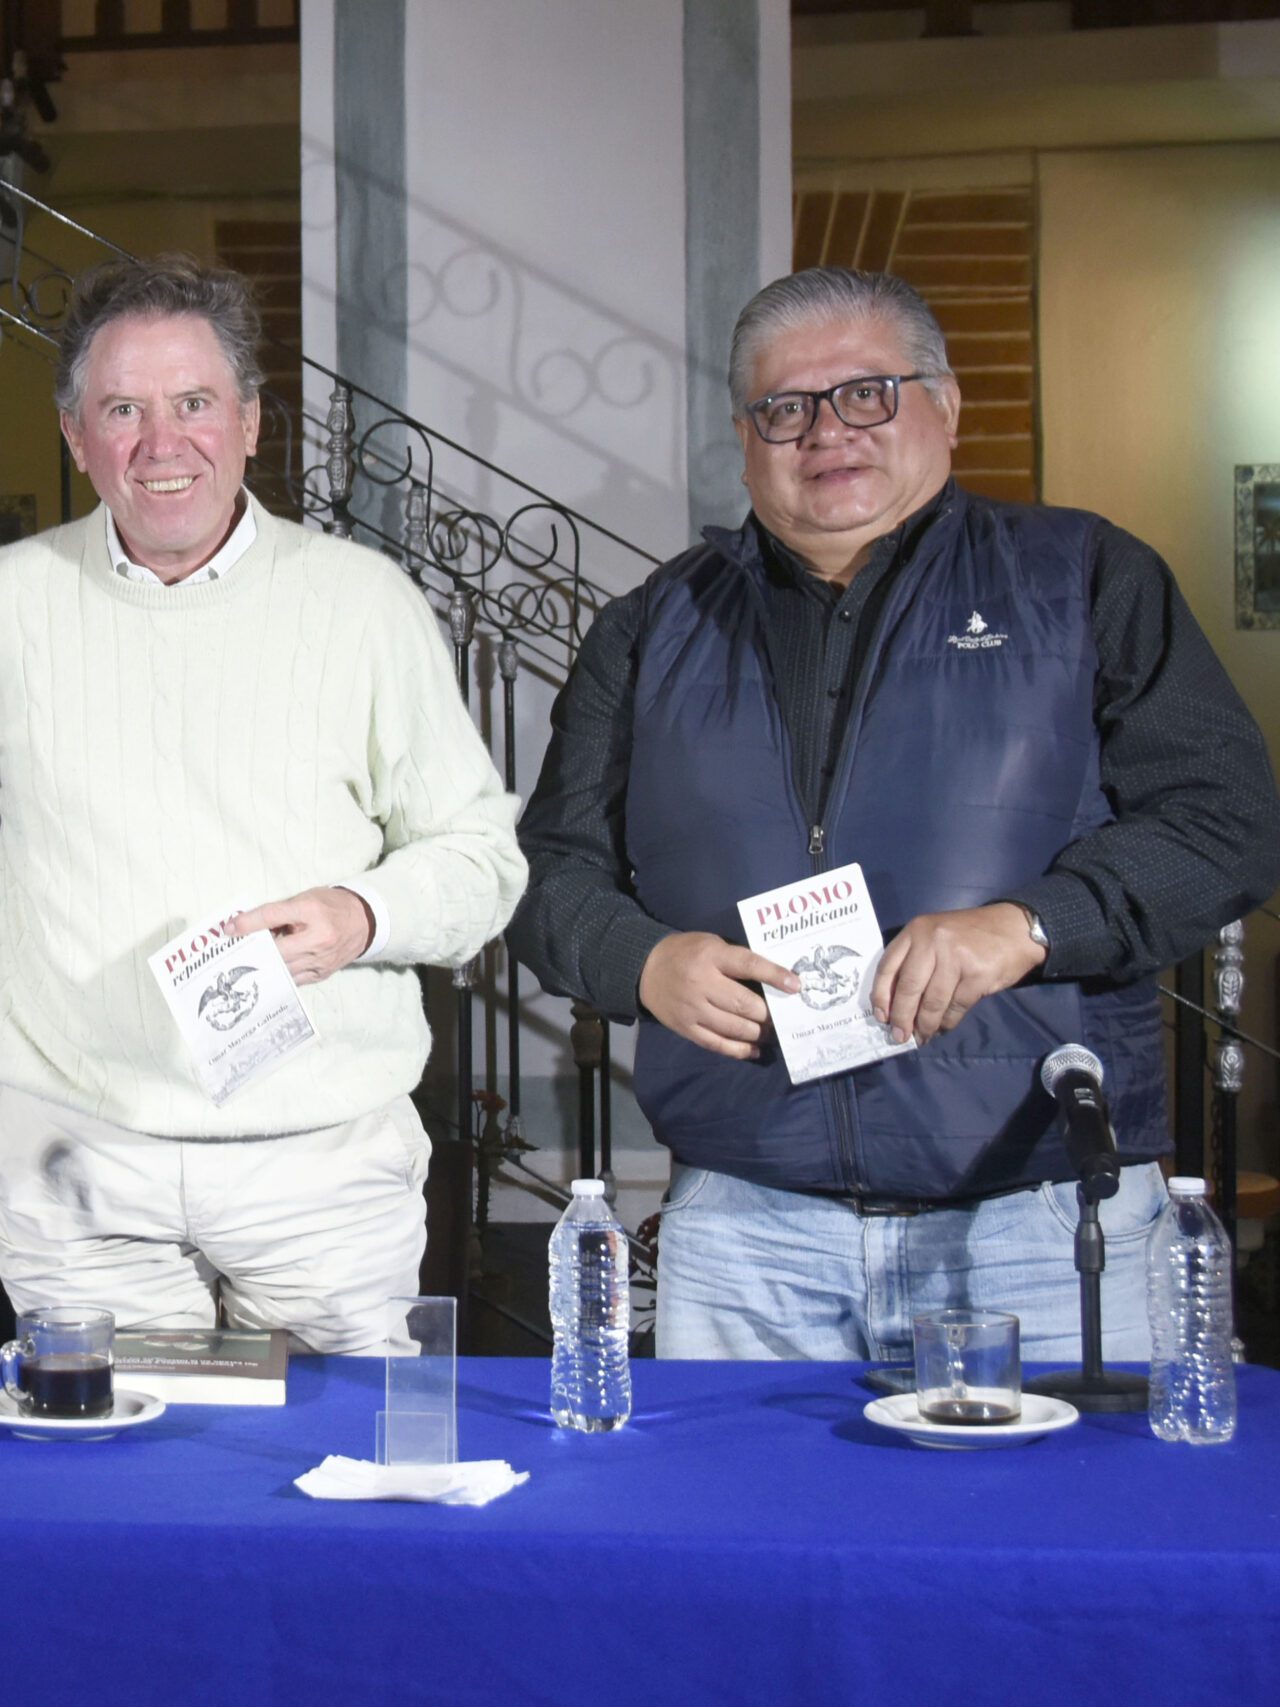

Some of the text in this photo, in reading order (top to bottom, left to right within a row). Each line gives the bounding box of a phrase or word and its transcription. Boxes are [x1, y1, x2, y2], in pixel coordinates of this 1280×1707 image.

[981, 640, 1002, 648] CLUB
[756, 880, 853, 926] PLOMO
[762, 902, 858, 942] republicano
[164, 910, 245, 974] PLOM
